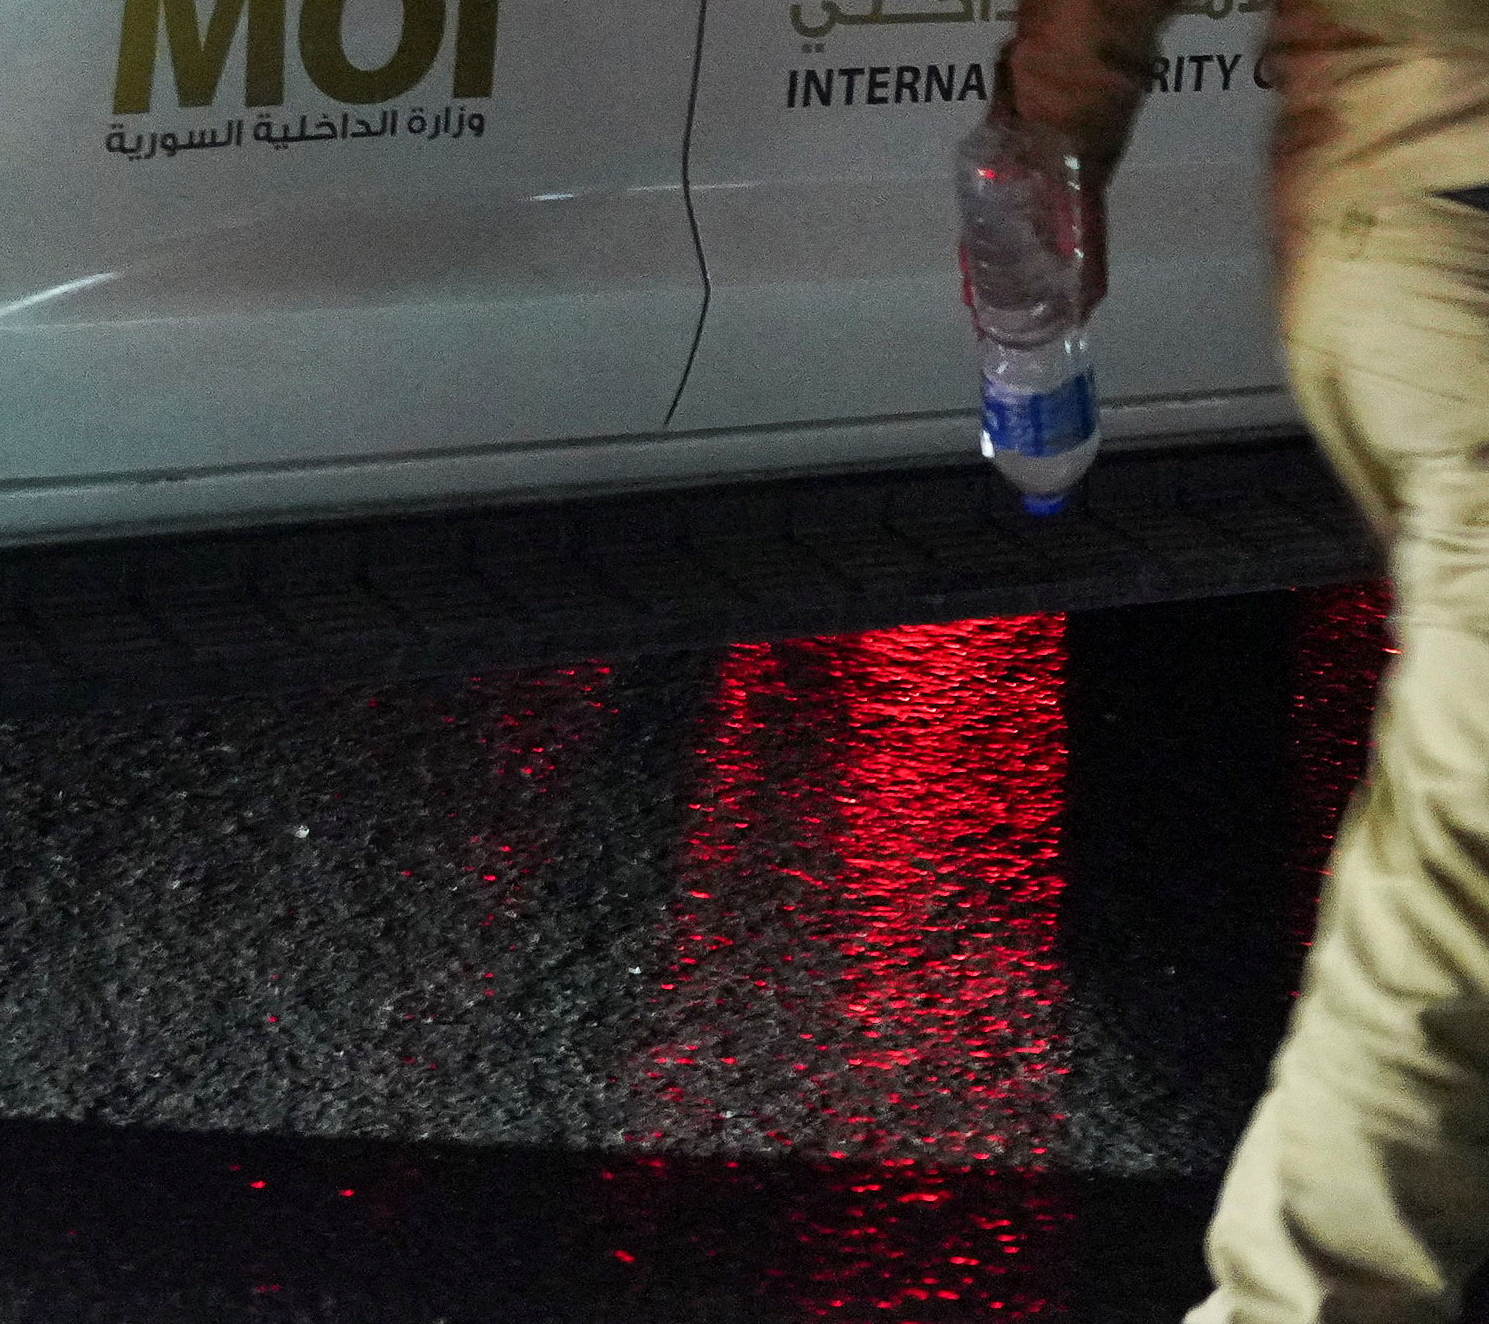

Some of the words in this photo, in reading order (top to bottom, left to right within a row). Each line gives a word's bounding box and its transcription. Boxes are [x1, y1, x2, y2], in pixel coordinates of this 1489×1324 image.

[786, 61, 991, 109] INTERNA
[105, 118, 245, 161] السورية
[252, 108, 399, 151] الداخلية
[406, 105, 487, 141] وزارة
